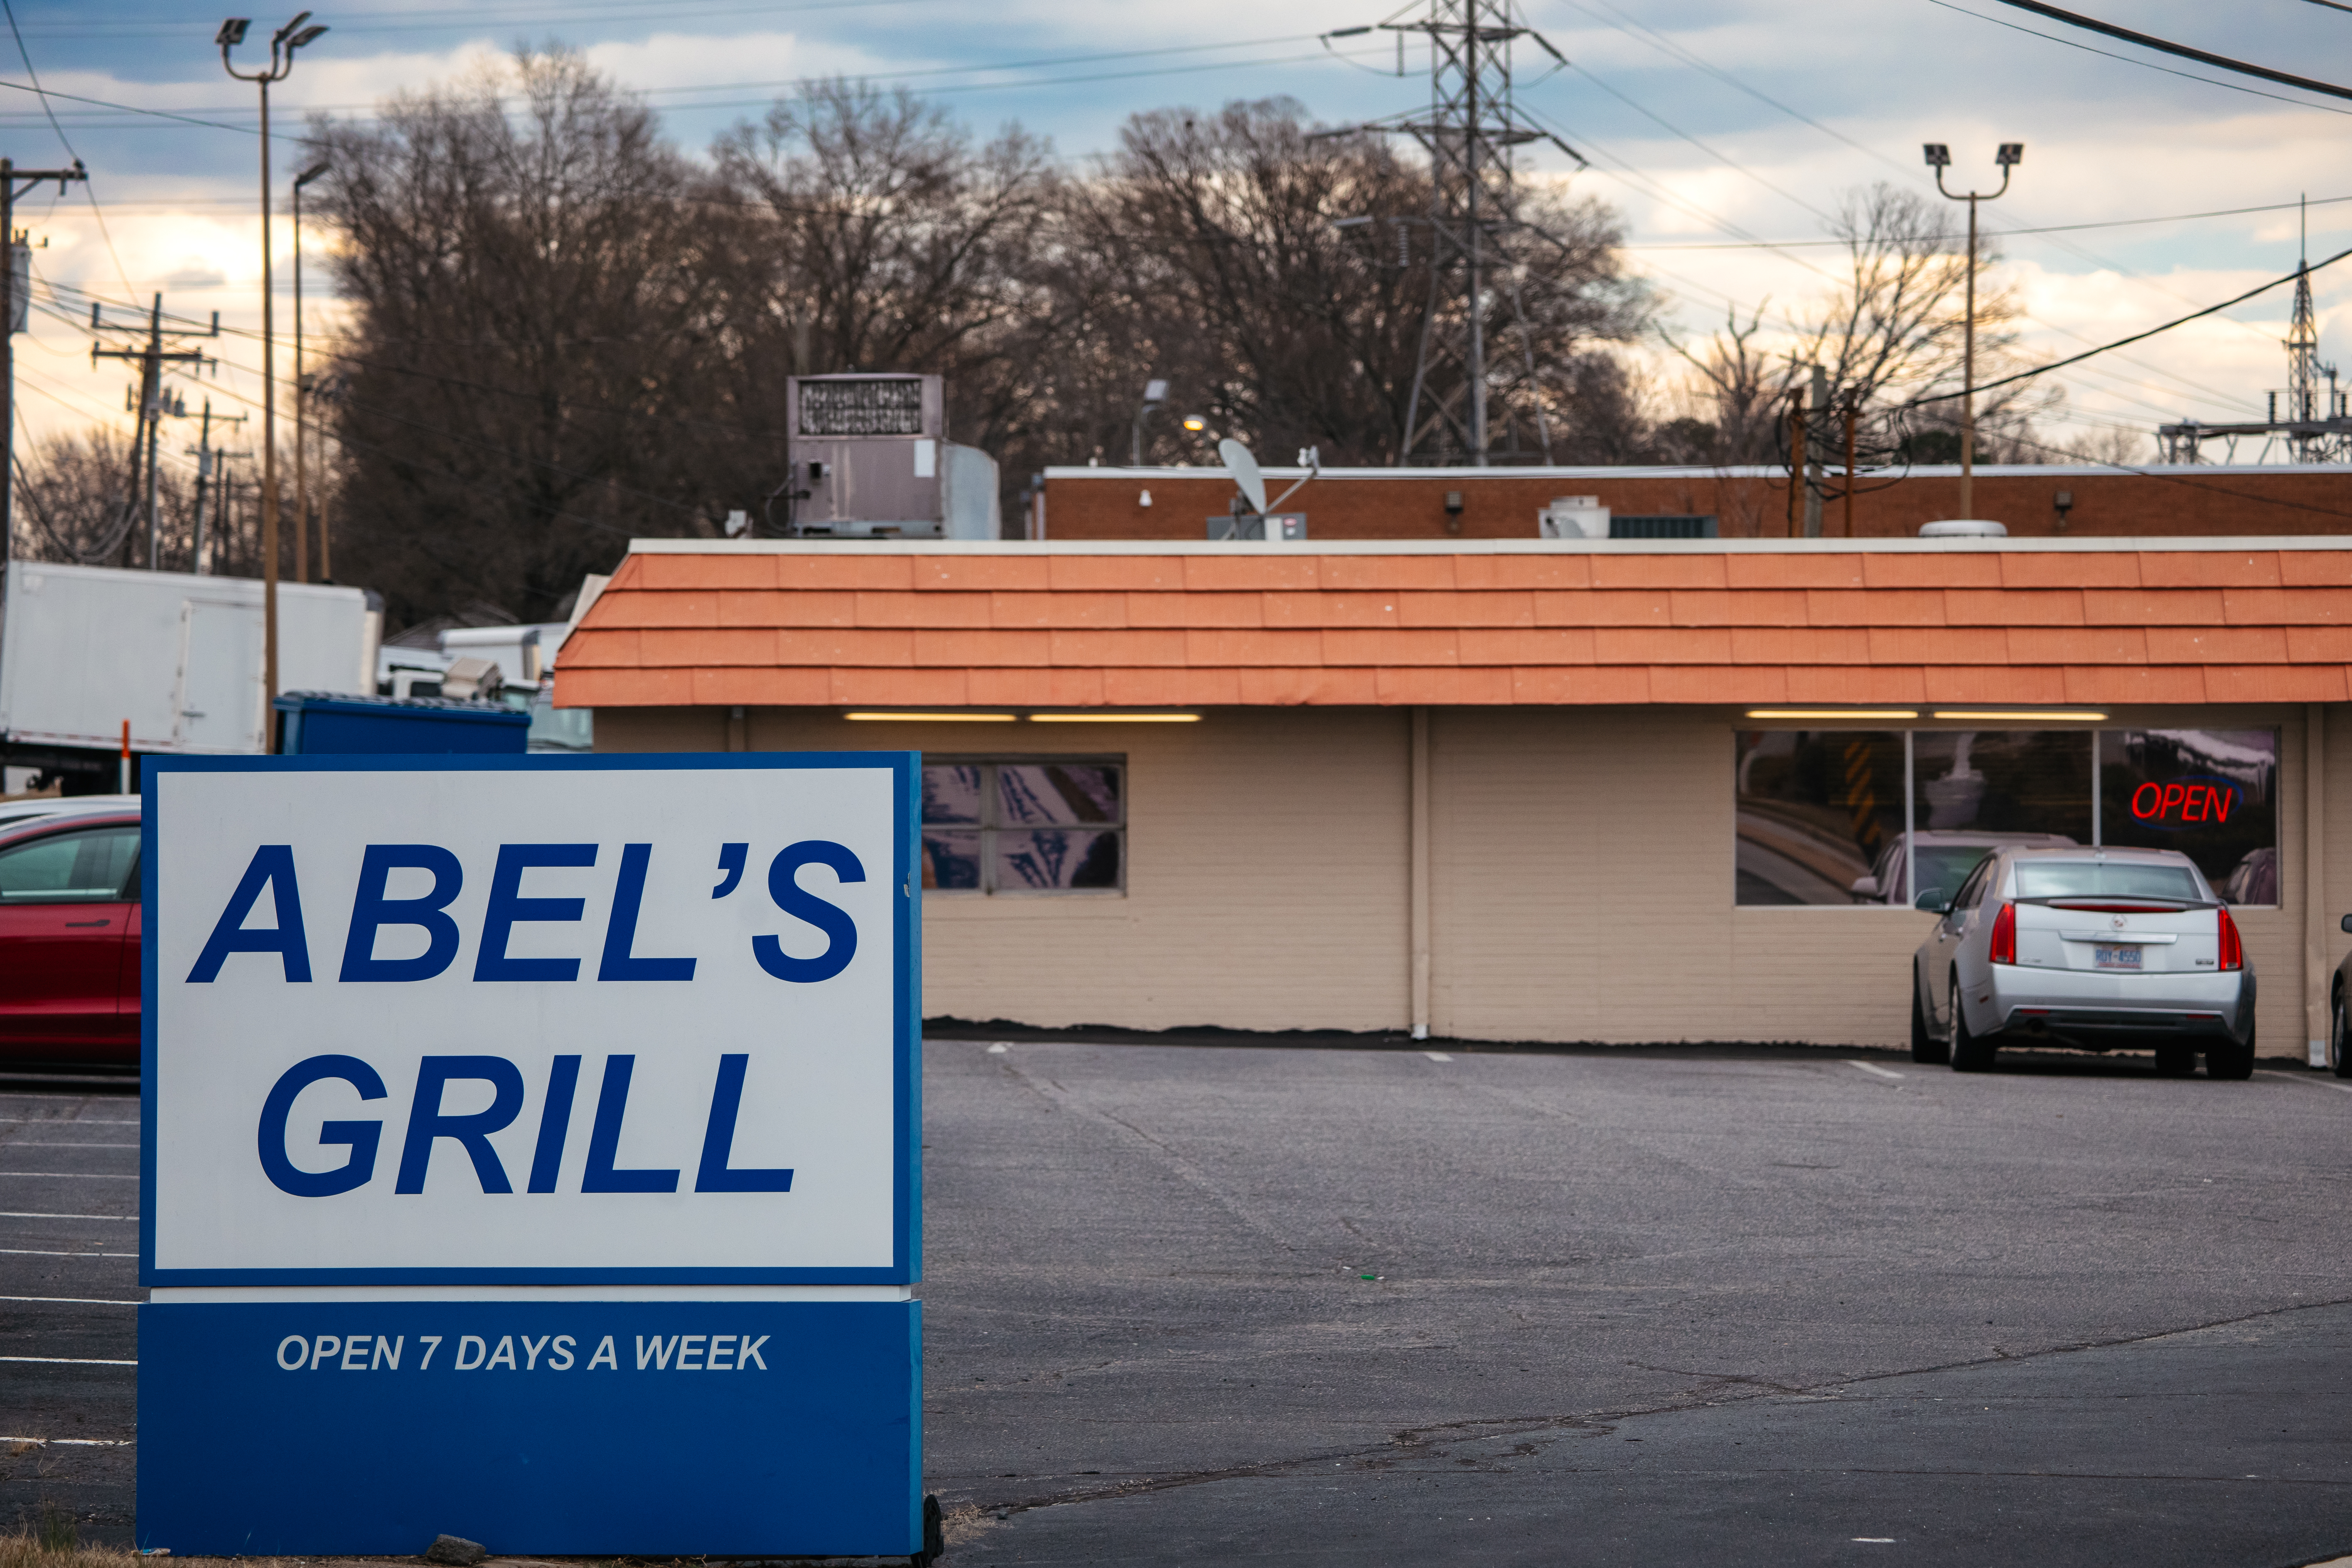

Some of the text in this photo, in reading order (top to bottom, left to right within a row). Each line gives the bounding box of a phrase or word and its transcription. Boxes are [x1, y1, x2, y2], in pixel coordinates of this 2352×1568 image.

[2133, 782, 2232, 822] OPEN
[186, 840, 866, 983] ABEL'S
[258, 1054, 794, 1197] GRILL
[277, 1335, 770, 1370] OPEN 7 DAYS A WEEK
